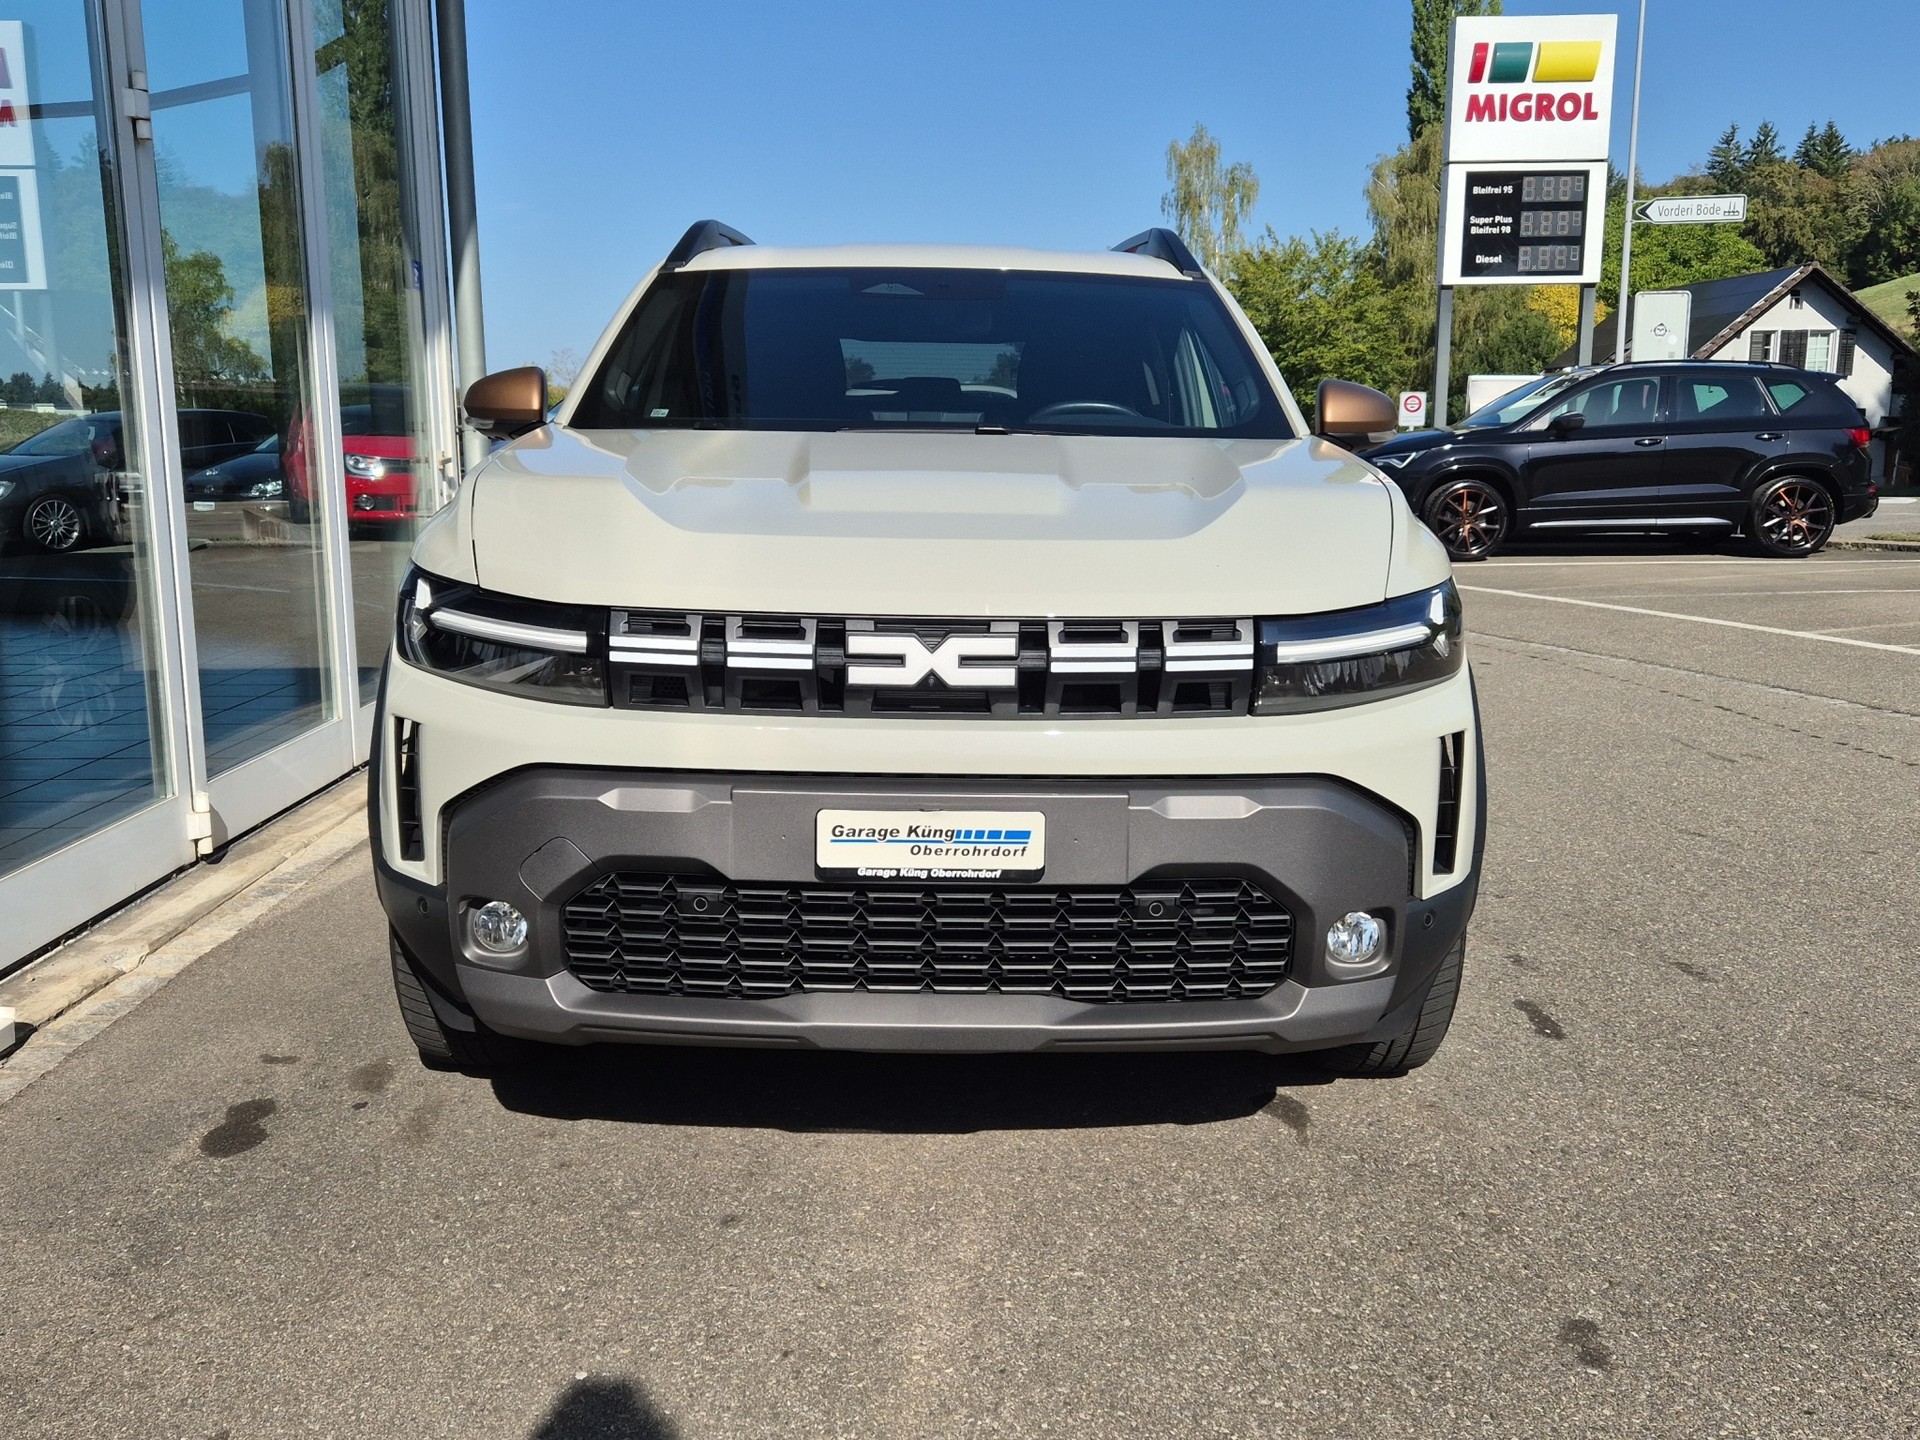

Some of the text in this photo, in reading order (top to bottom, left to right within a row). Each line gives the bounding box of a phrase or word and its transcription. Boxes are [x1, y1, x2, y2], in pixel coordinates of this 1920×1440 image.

[1465, 92, 1598, 122] MIGROL
[1472, 185, 1513, 194] Bleifrei 95
[1658, 204, 1693, 217] Vorderi
[1470, 215, 1513, 225] Super Plus
[1470, 225, 1511, 234] Bleifrei 98
[1475, 254, 1503, 264] Diesel
[831, 824, 955, 842] Garage Küng
[909, 844, 1028, 857] Oberrohrdorf
[857, 866, 1002, 879] Garage Küng Oberrohrdorf
